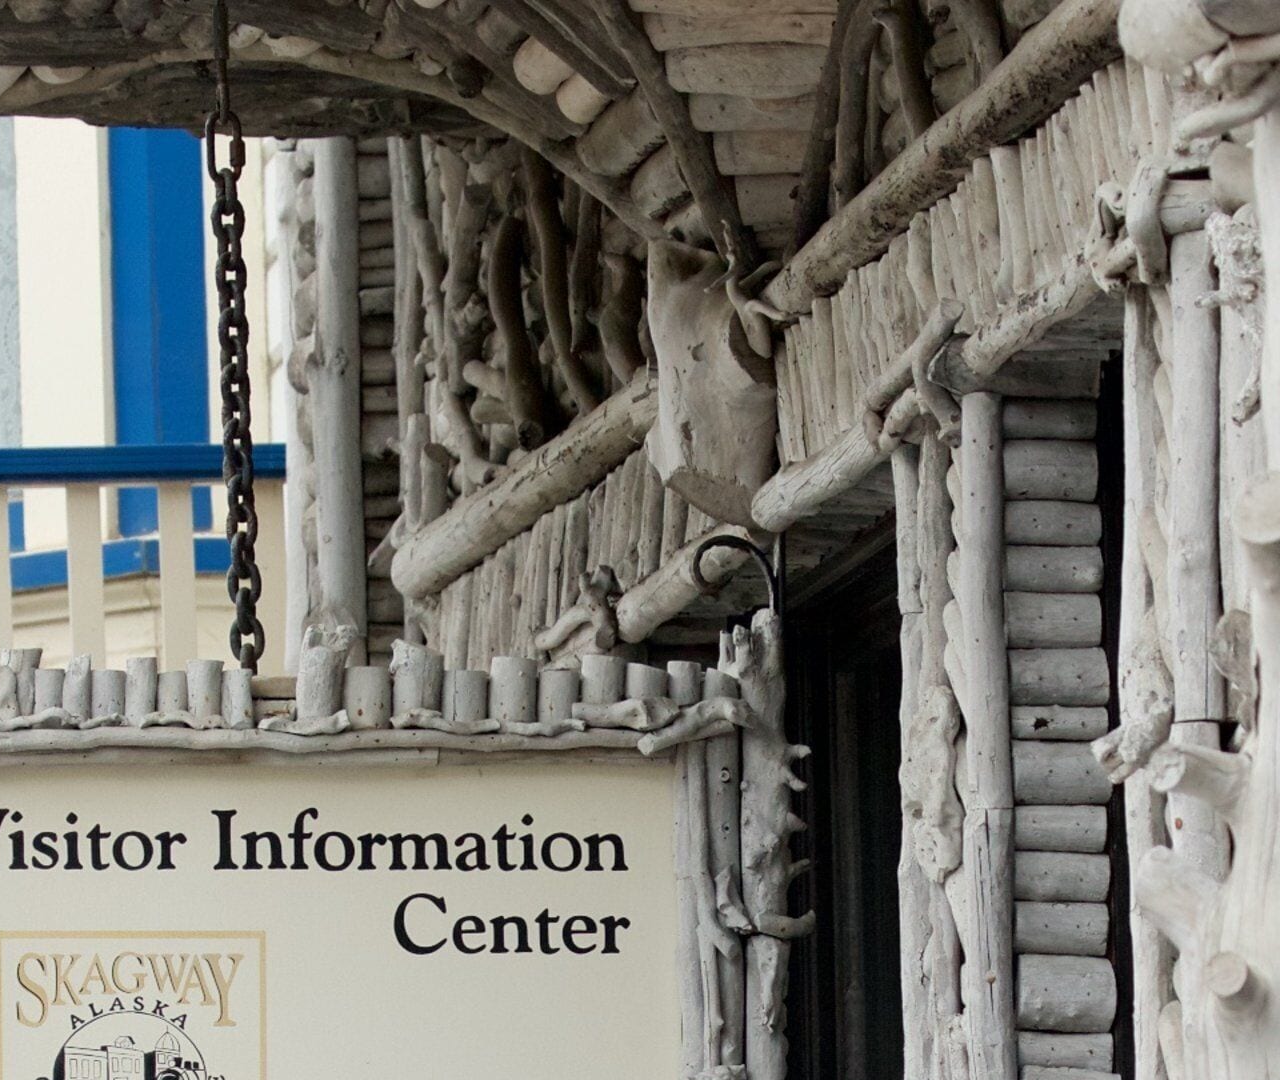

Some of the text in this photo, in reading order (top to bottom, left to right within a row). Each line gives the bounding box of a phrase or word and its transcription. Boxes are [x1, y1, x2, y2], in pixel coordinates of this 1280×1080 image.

[210, 807, 629, 873] Information
[393, 892, 631, 956] Center
[15, 950, 245, 1029] SKAGWAY
[70, 996, 188, 1030] ALASKA
